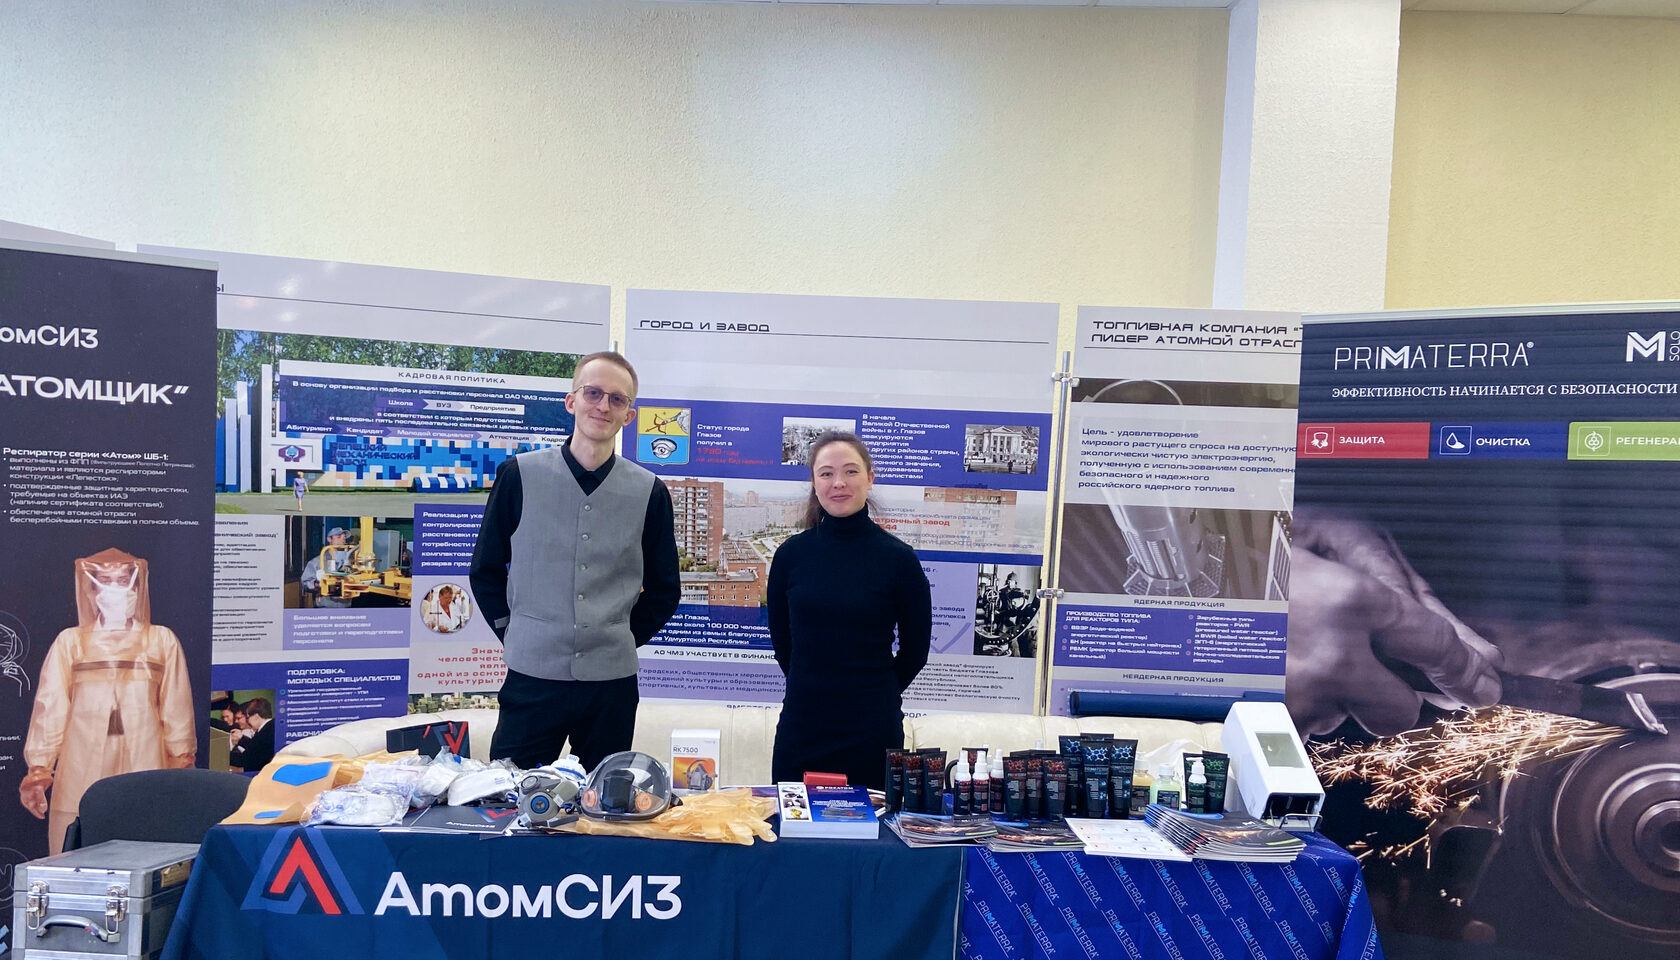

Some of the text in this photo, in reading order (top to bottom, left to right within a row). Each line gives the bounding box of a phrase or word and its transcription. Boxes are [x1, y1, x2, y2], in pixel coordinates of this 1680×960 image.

[640, 320, 770, 332] ГОРОД И ЗАВОД
[1092, 321, 1194, 332] ТОПЛИВНАЯ
[1199, 324, 1288, 335] КОМПАНИЯ
[1091, 333, 1149, 343] ЛИДЕР
[1155, 334, 1233, 346] АТОМНОЙ
[398, 371, 506, 384] КАДРОВАЯ ПОЛИТИКА
[329, 384, 379, 392] организации
[1332, 383, 1678, 398] ЭФФЕКТИВНОСТЬ НАЧИНАЕТСЯ С БЕЗОПАСНОСТИ
[388, 399, 414, 407] Школа
[470, 404, 516, 413] Предприятие
[286, 424, 333, 432] Абитуриент
[346, 427, 384, 435] Кандидат
[894, 421, 950, 429] Отечественной
[1117, 430, 1199, 439] удовлетворение
[1339, 436, 1385, 445] ЗАЩИТА
[1475, 438, 1531, 447] ОЧИСТКА
[1132, 441, 1187, 449] растущего
[1189, 443, 1226, 451] спроса
[1242, 445, 1297, 453] доступную
[3, 447, 67, 458] Респиратор
[68, 451, 100, 459] серии
[143, 452, 169, 461] ШБ-1:
[1080, 450, 1149, 458] экологически
[1191, 454, 1276, 463] электроэнергию,
[1079, 460, 1141, 468] полученную
[9, 465, 56, 473] материала
[105, 468, 166, 476] респираторами
[1079, 470, 1143, 478] безопасного
[9, 473, 64, 481] конструкции
[1078, 481, 1142, 489] российского
[9, 491, 56, 499] требуемые
[67, 509, 103, 517] атомной
[103, 511, 137, 519] отрасли
[422, 511, 469, 519] Реализация
[9, 516, 82, 524] бесперебойными
[664, 635, 750, 646] Удмуртской Республики
[686, 650, 733, 658] УЧАСТВУЕТ
[287, 668, 346, 676] ПОДГОТОВКА:
[417, 670, 453, 679] одной
[333, 675, 402, 683] СПЕЦИАЛИСТОВ
[1122, 673, 1224, 683] НЕЯДЕРНАЯ ПРОДУКЦИЯ
[1066, 851, 1102, 903] PRIMATERRA
[375, 871, 683, 920] АтомСИЗ
[1283, 864, 1319, 917] PRIMATERRA
[977, 900, 1014, 953] PRIMATERRA
[1020, 902, 1056, 958] PRIMATERRA
[1062, 906, 1100, 958] PRIMATERRA
